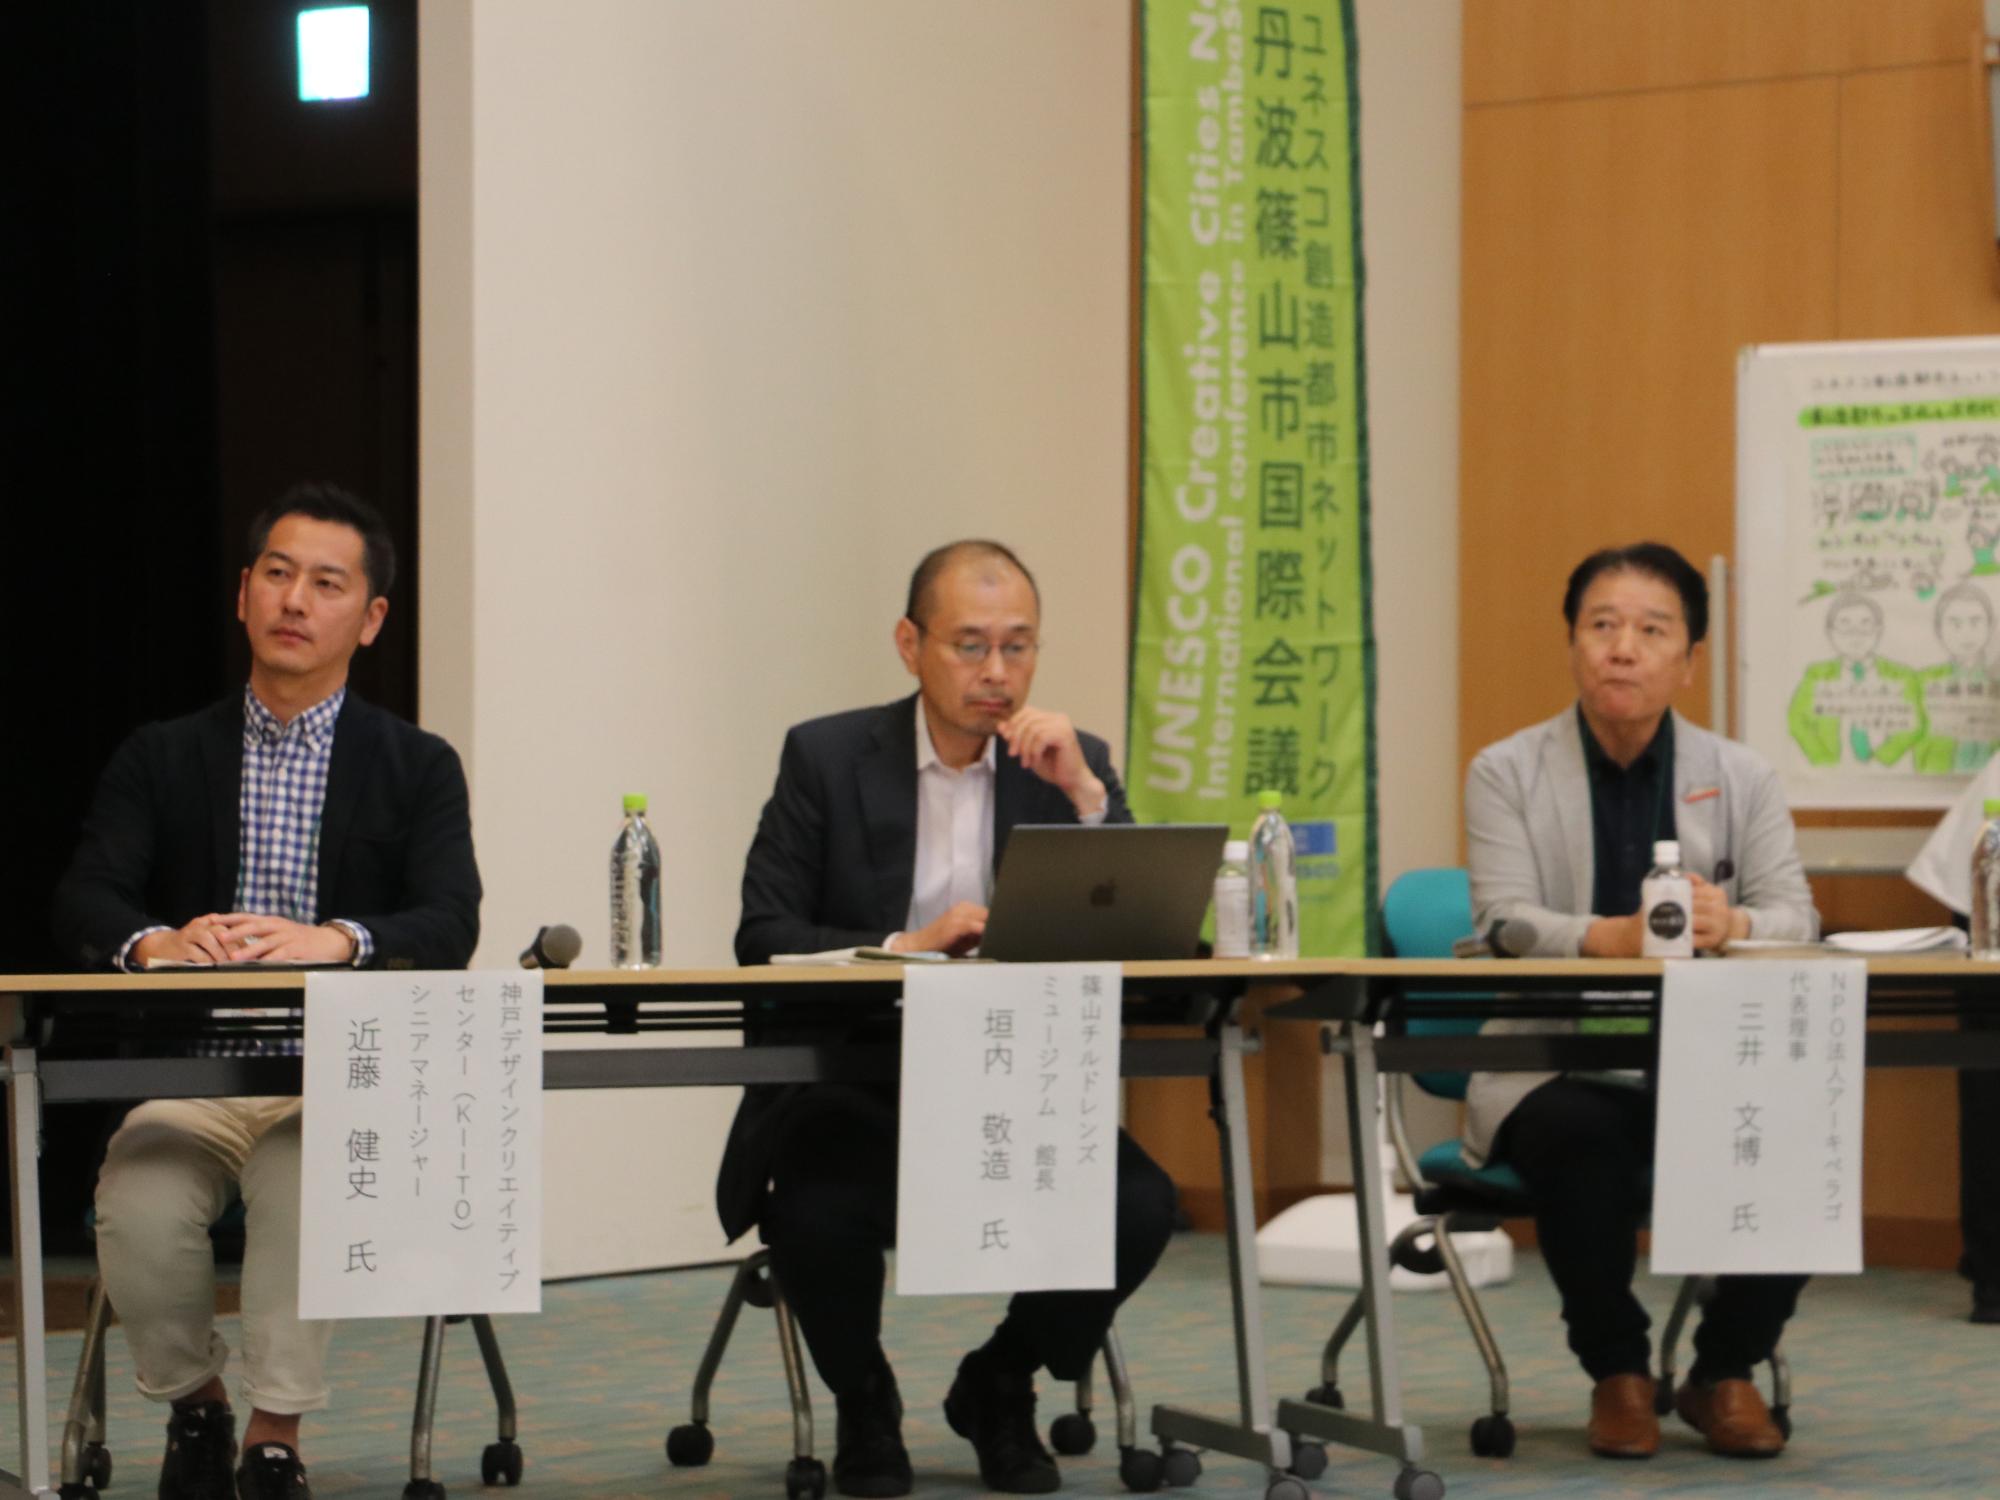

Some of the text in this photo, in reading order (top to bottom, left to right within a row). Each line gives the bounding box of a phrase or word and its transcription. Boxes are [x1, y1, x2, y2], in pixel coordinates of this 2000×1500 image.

[1146, 0, 1221, 793] UNESCO Creative Cities N
[1197, 516, 1245, 799] International
[1223, 204, 1245, 243] in
[1245, 7, 1304, 796] 丹波篠山市国際会議
[1301, 15, 1340, 799] ユネスコ創造都市ネットワーク
[344, 1018, 381, 1274] 近藤 健史 氏
[410, 985, 431, 1197] シニアマネージャー
[979, 1008, 1015, 1251] 垣内 敬造 氏
[1039, 976, 1059, 1117] ミュージアム
[1078, 974, 1102, 1166] 篠山チルドレンズ
[1737, 1002, 1764, 1067] 三井
[1731, 1202, 1759, 1234] 氏
